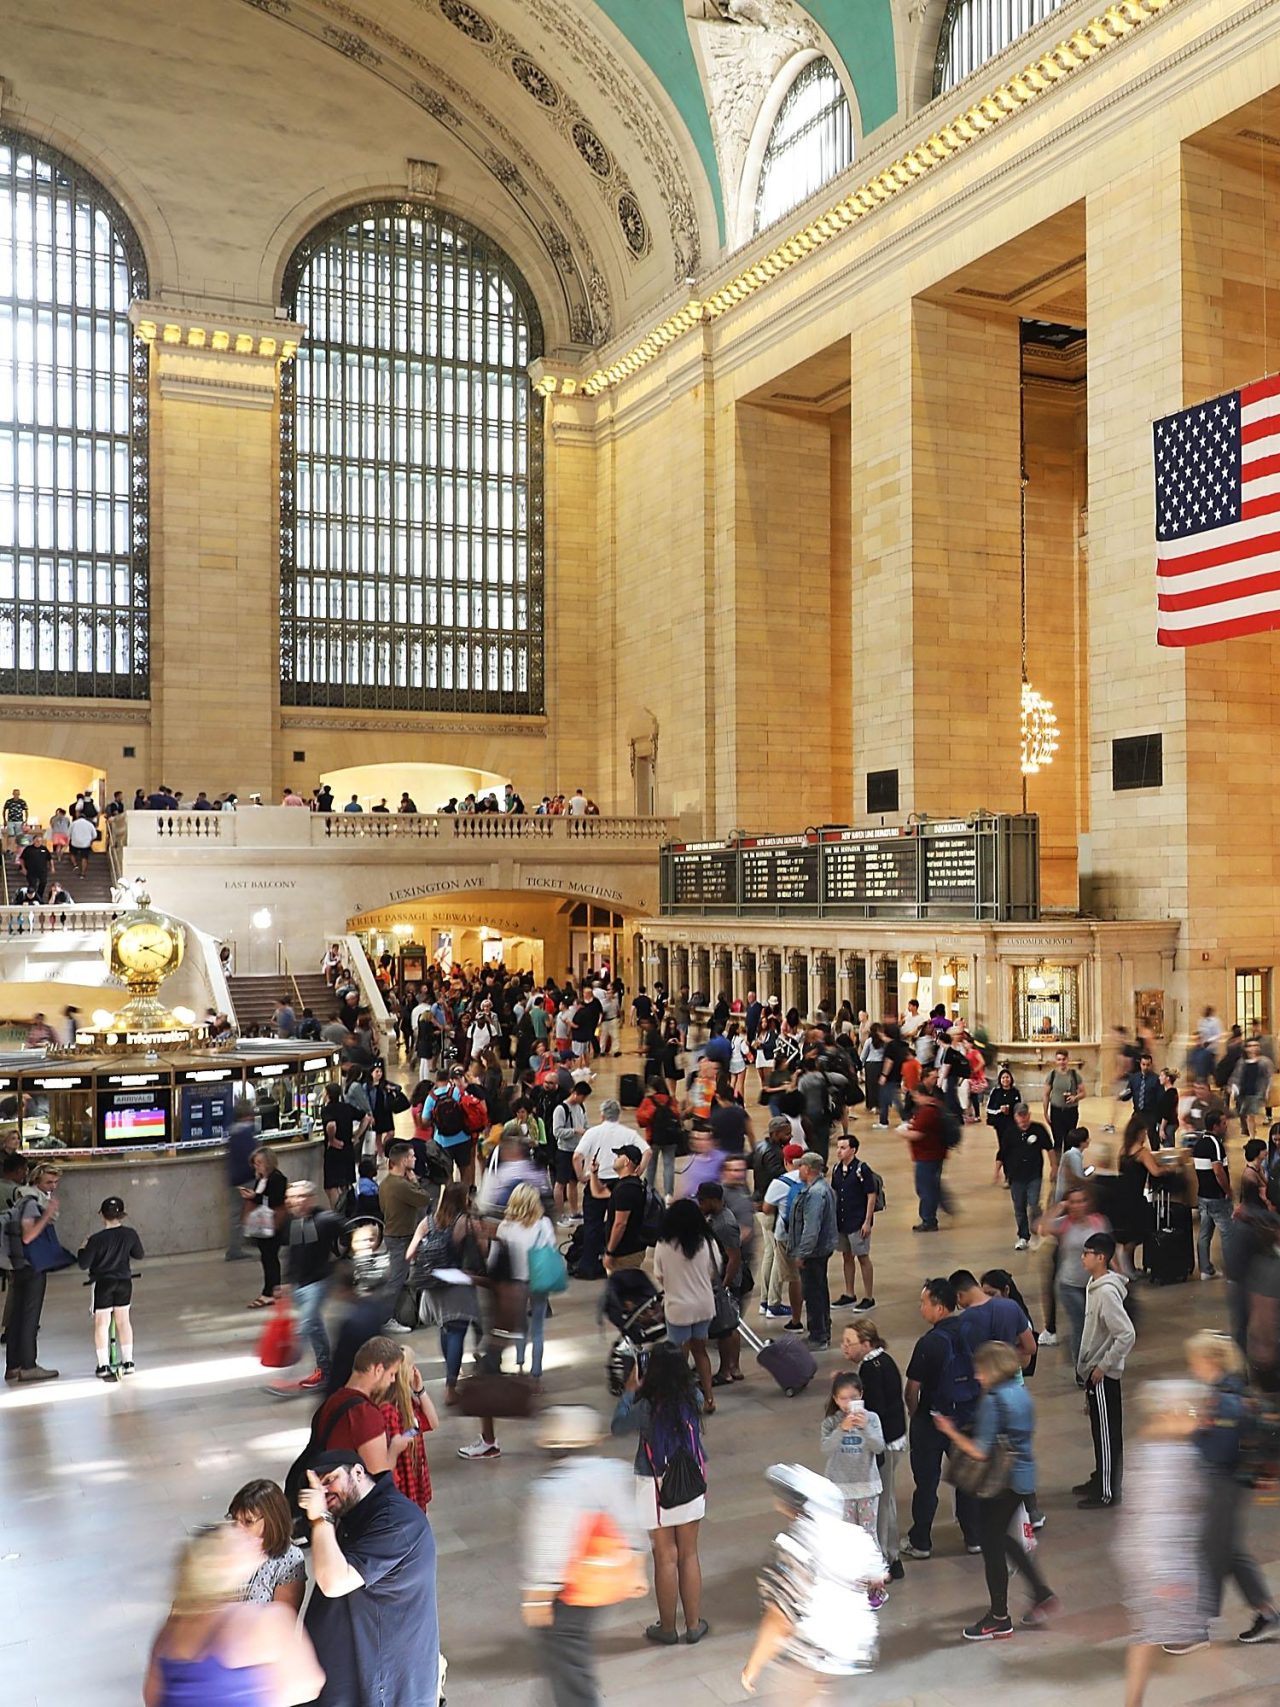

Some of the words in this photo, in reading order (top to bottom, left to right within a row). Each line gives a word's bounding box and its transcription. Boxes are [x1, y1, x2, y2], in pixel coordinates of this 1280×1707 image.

[225, 881, 247, 889] EAST
[251, 880, 296, 889] BALCONY
[389, 881, 459, 900] LEXINGTON
[463, 877, 485, 887] AVE
[526, 877, 563, 889] TICKET
[568, 881, 623, 901] MACHINES
[432, 912, 473, 922] SUBWAY
